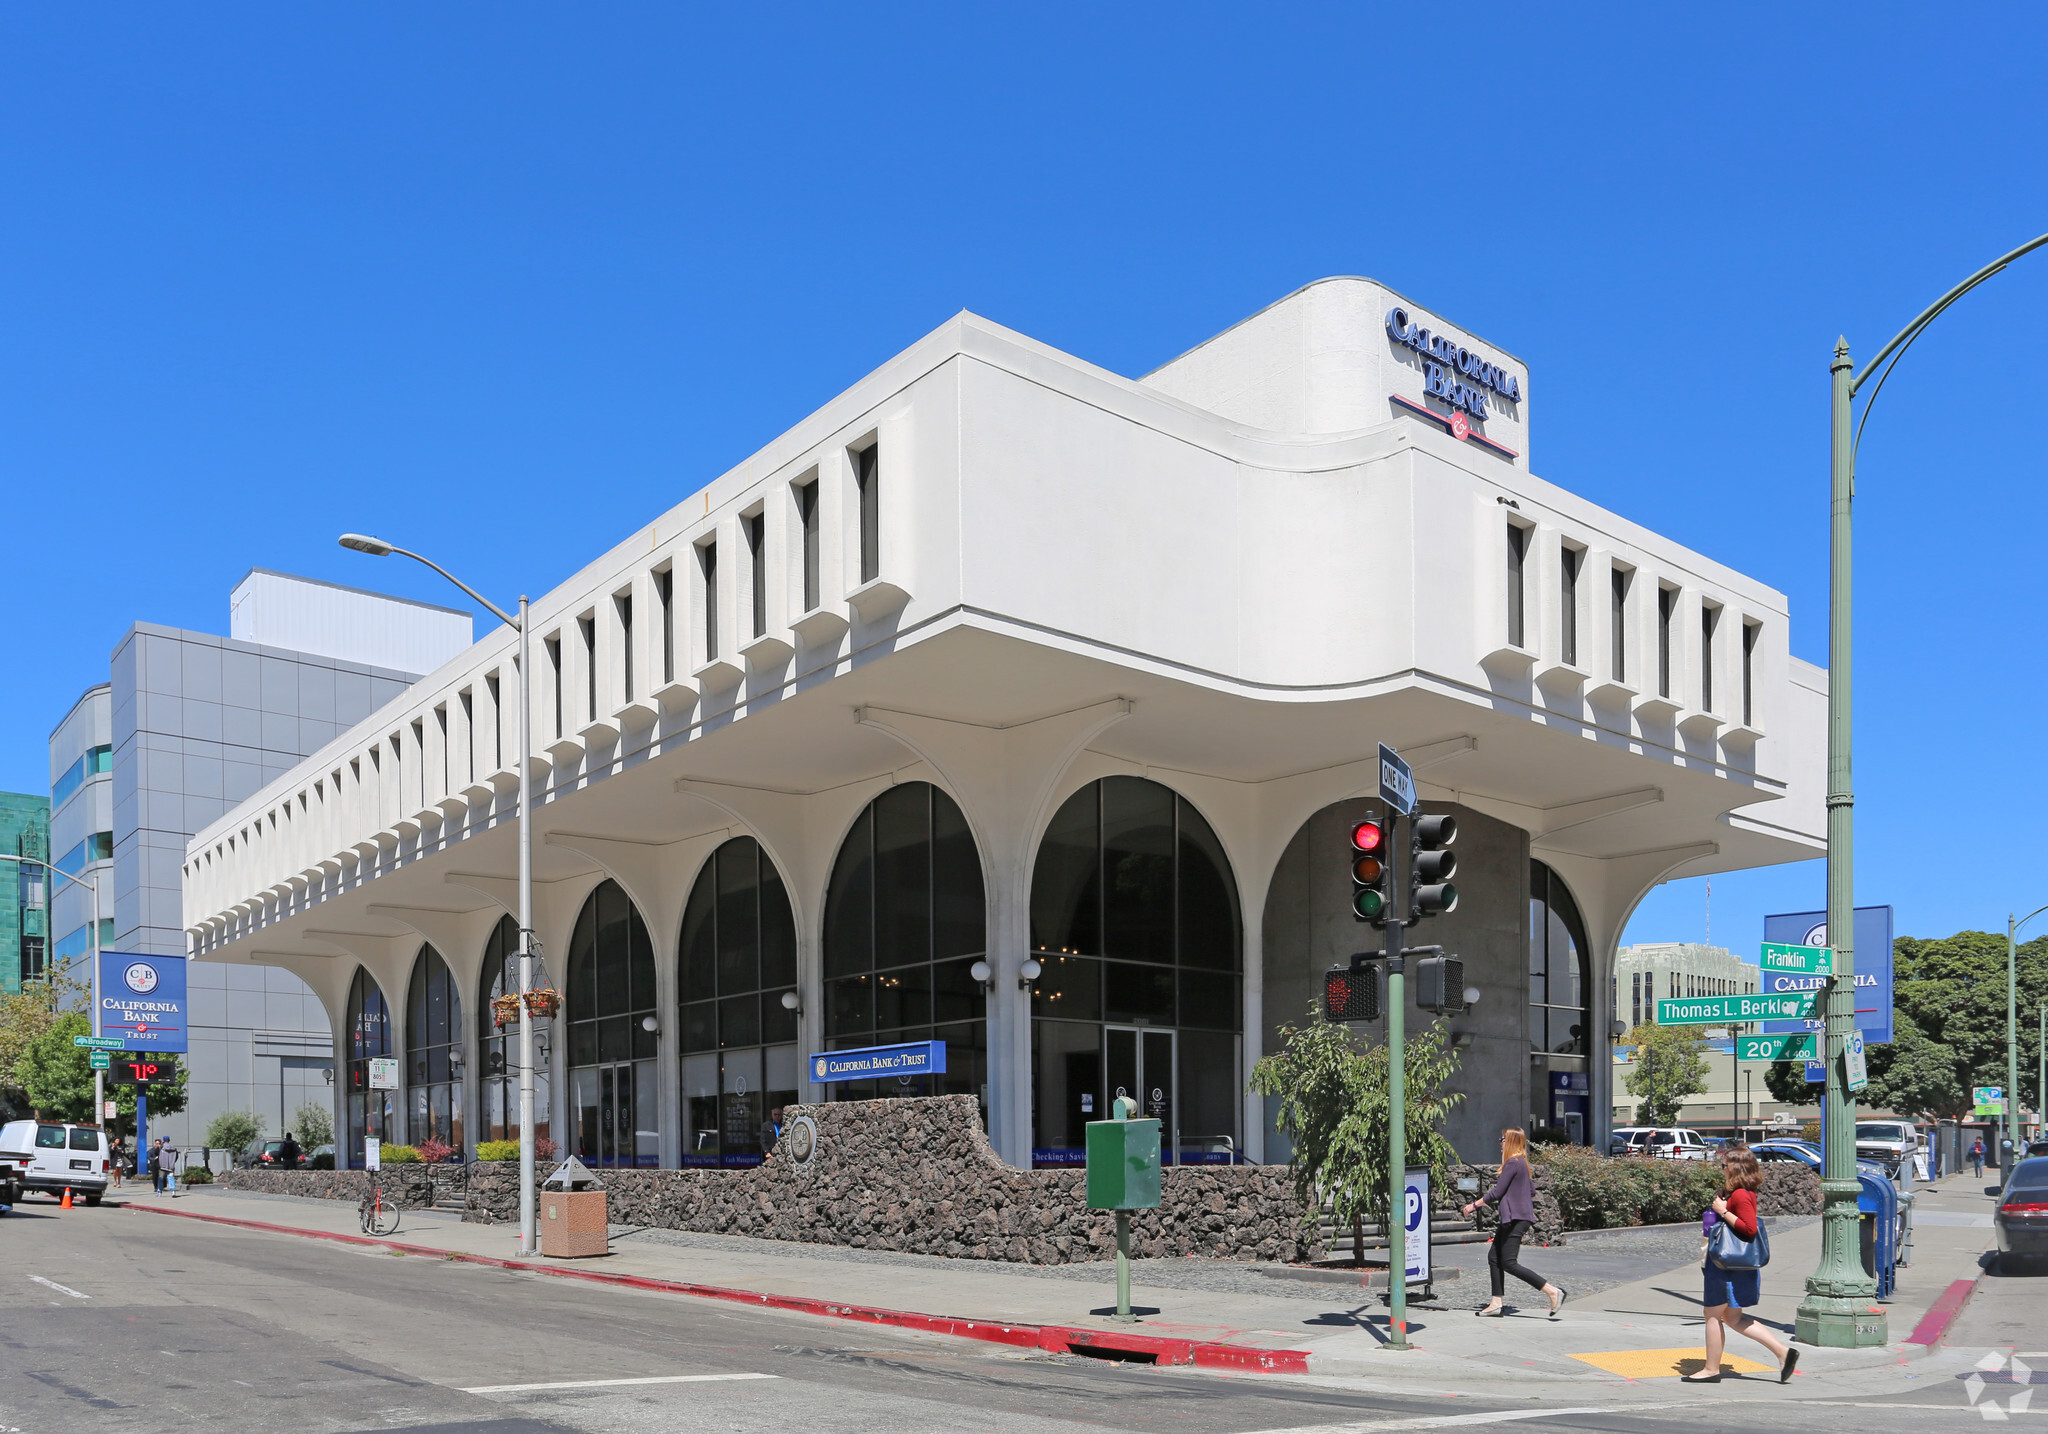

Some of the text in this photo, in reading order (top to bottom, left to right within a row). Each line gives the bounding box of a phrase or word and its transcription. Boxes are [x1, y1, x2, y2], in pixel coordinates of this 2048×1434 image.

[1385, 307, 1521, 404] CALIFORNIA
[1422, 361, 1489, 422] BANK
[1383, 764, 1408, 798] ONE WAY
[1767, 948, 1826, 968] Franklin ST
[1814, 965, 1830, 973] 2000
[102, 997, 179, 1013] CALIFORNIA
[1663, 1003, 1721, 1019] Thomas
[1724, 1001, 1737, 1016] L.
[1800, 1009, 1816, 1017] 400
[123, 1010, 160, 1023] BANK
[87, 1037, 123, 1047] Broadway
[125, 1031, 158, 1040] TRUST
[1747, 1037, 1807, 1058] 20th ST
[1793, 1050, 1811, 1058] 400
[829, 1060, 871, 1073] CALIFORNIA
[872, 1057, 893, 1069] BANK
[893, 1055, 901, 1067] &
[901, 1053, 927, 1066] TRUST
[1031, 1152, 1064, 1162] Checking
